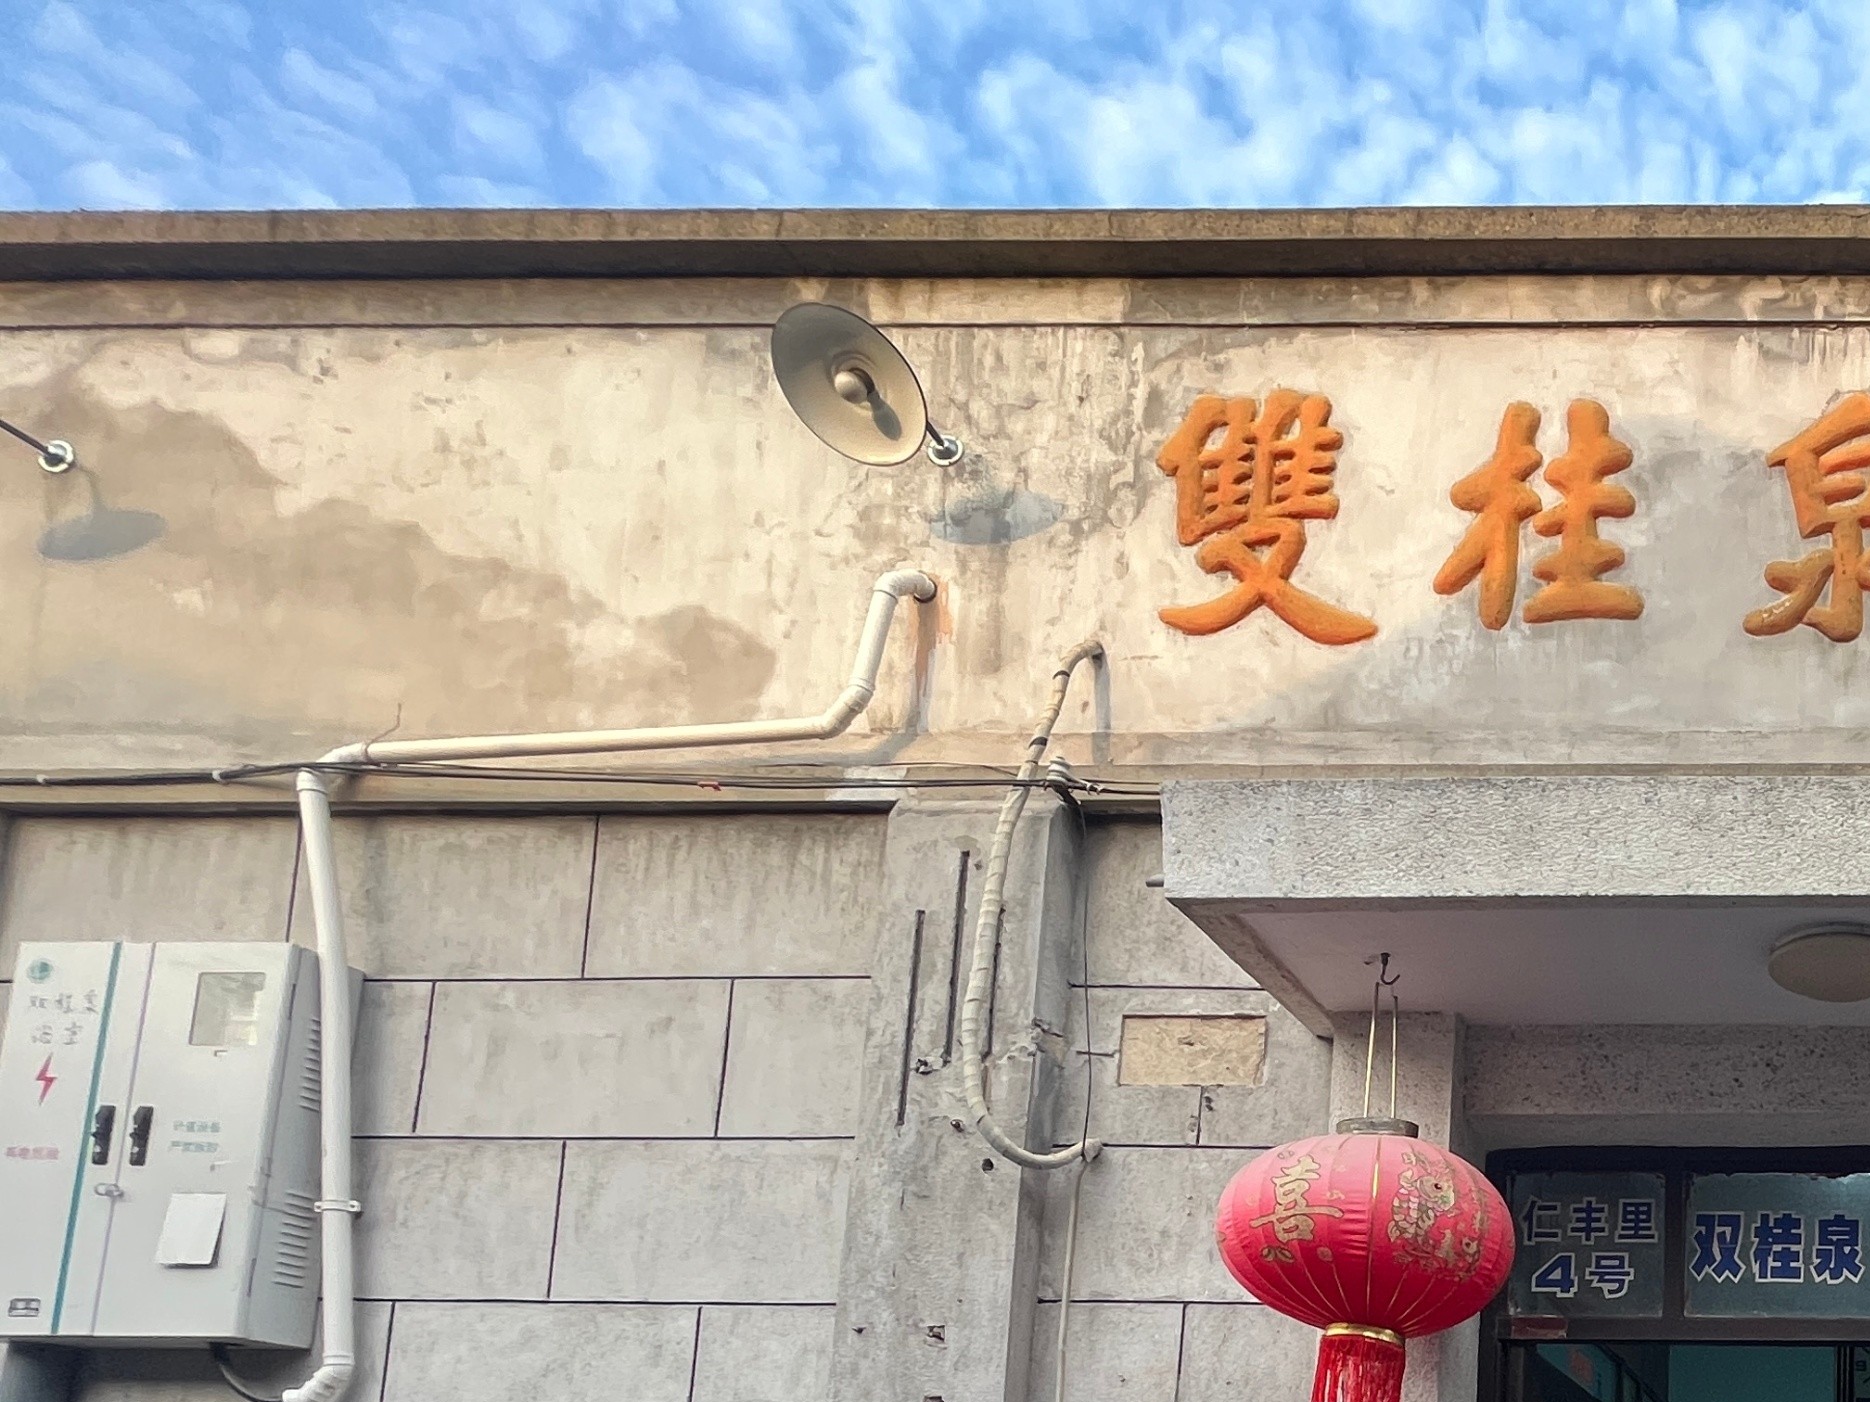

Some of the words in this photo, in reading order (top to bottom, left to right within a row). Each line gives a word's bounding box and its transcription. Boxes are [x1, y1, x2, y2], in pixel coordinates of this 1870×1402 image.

[1250, 1154, 1344, 1243] 喜
[1518, 1195, 1658, 1245] 仁丰里
[1531, 1252, 1635, 1299] 4号
